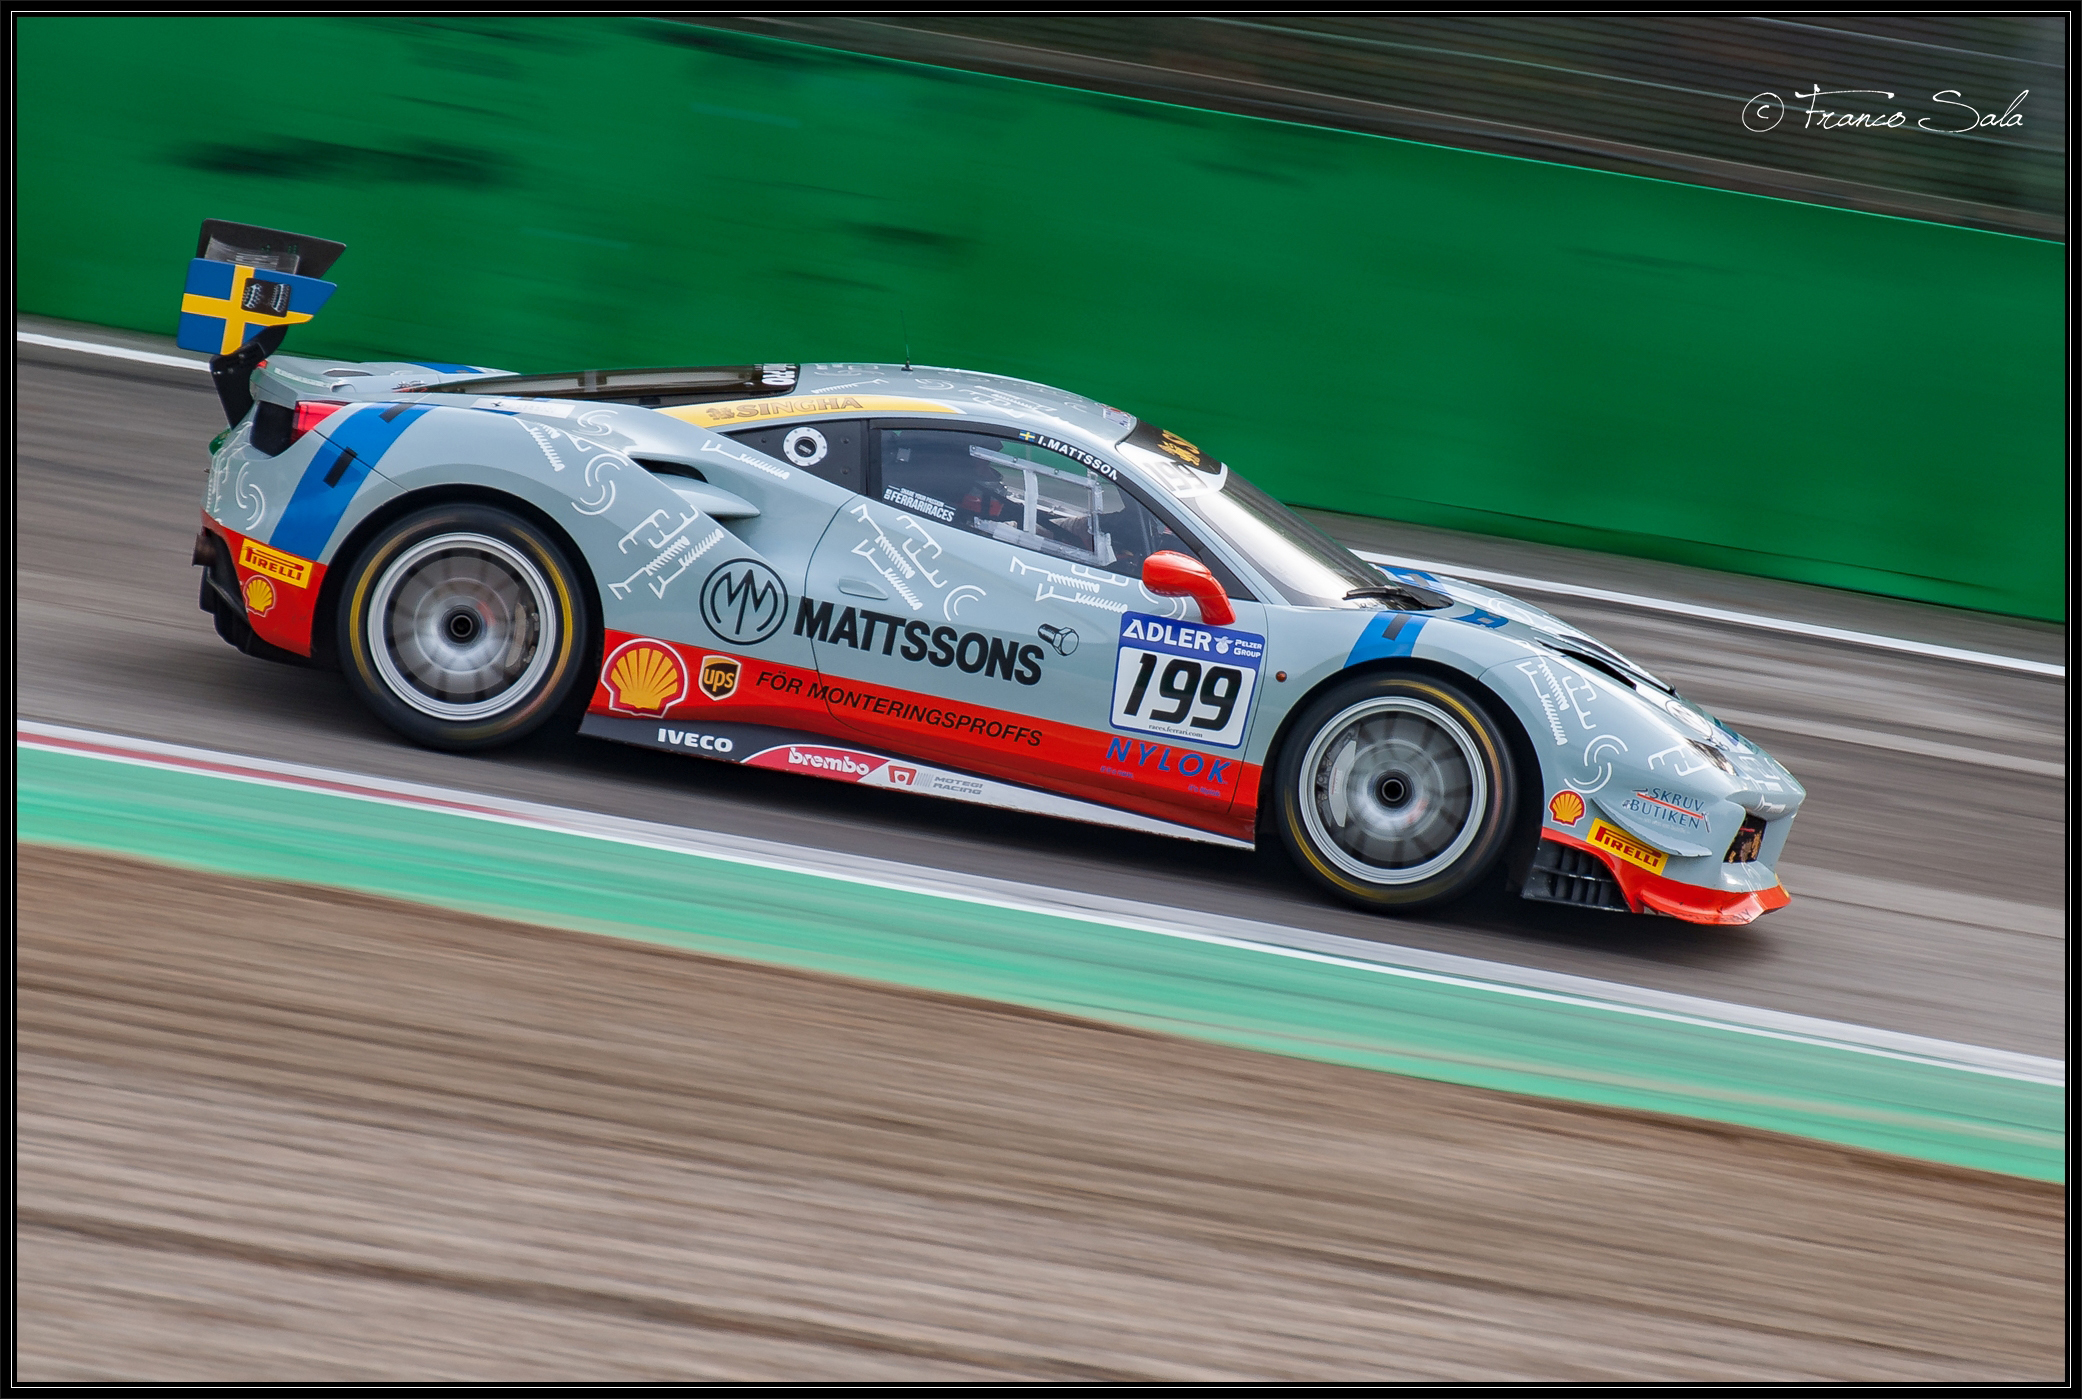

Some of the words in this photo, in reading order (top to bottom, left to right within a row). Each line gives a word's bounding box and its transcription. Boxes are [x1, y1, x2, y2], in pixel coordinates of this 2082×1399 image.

[735, 396, 864, 419] SINGHA
[1037, 434, 1119, 481] I.MATTSSON
[245, 547, 304, 580] PIRELLI
[793, 596, 1045, 686] MATTSSONS
[1122, 618, 1212, 652] ADLER
[1234, 639, 1263, 651] PELZER
[1233, 647, 1261, 658] GROUP
[703, 668, 735, 692] ups
[1123, 653, 1243, 731] 199
[756, 671, 804, 696] FÖR
[806, 682, 1043, 748] MONTERINGSPROFFS
[657, 727, 733, 754] IVECO
[1148, 724, 1204, 738] races.ferrari.com
[788, 747, 870, 776] brembo
[1106, 737, 1231, 783] NYLOK
[932, 782, 983, 796] RACING
[934, 776, 985, 790] MOTEGI
[1629, 798, 1701, 830] BUTIKEN
[1651, 787, 1705, 812] SKRUV
[1595, 826, 1662, 867] PIRELLI
